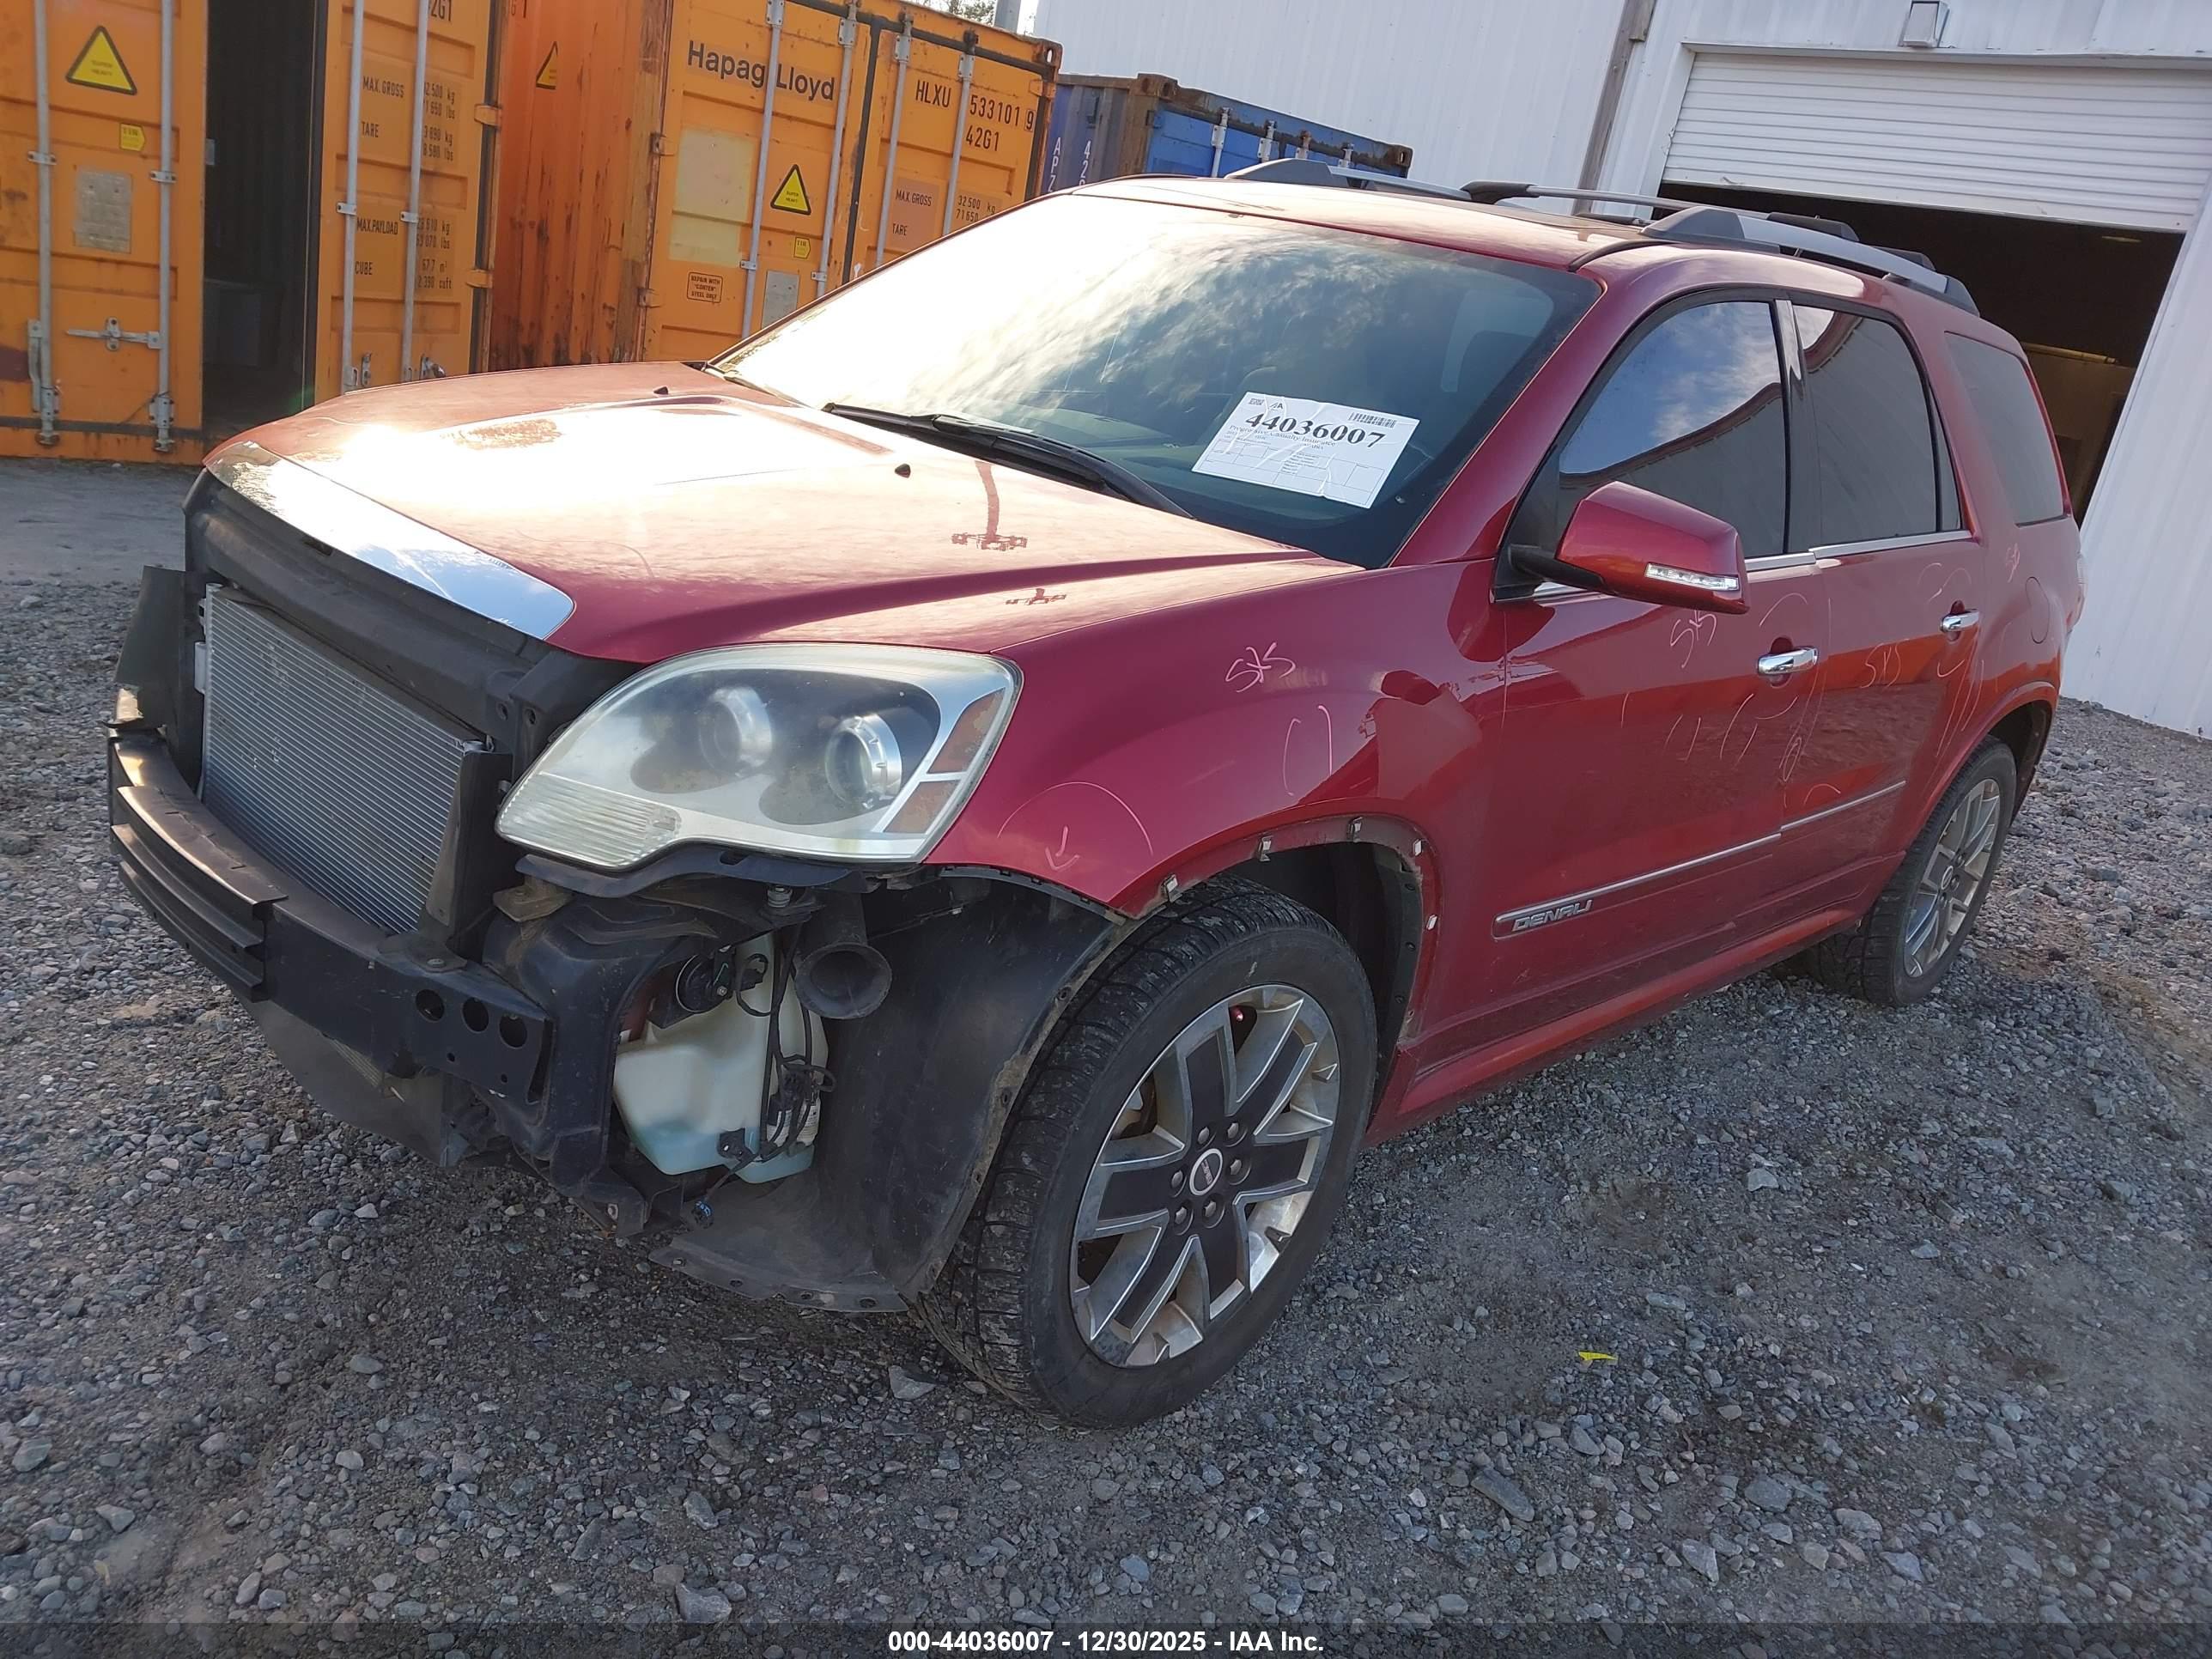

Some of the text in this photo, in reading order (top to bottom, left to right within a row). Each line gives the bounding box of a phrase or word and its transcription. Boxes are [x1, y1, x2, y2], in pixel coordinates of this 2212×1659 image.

[688, 40, 836, 100] Hapag Lloyd
[915, 80, 1035, 130] HLXU 533101 9
[362, 121, 380, 137] TARE
[965, 125, 1000, 151] 42G1
[892, 223, 908, 236] TARE
[355, 260, 374, 275] CUBE
[1245, 413, 1387, 447] 44036007
[1511, 899, 1593, 933] DENALI
